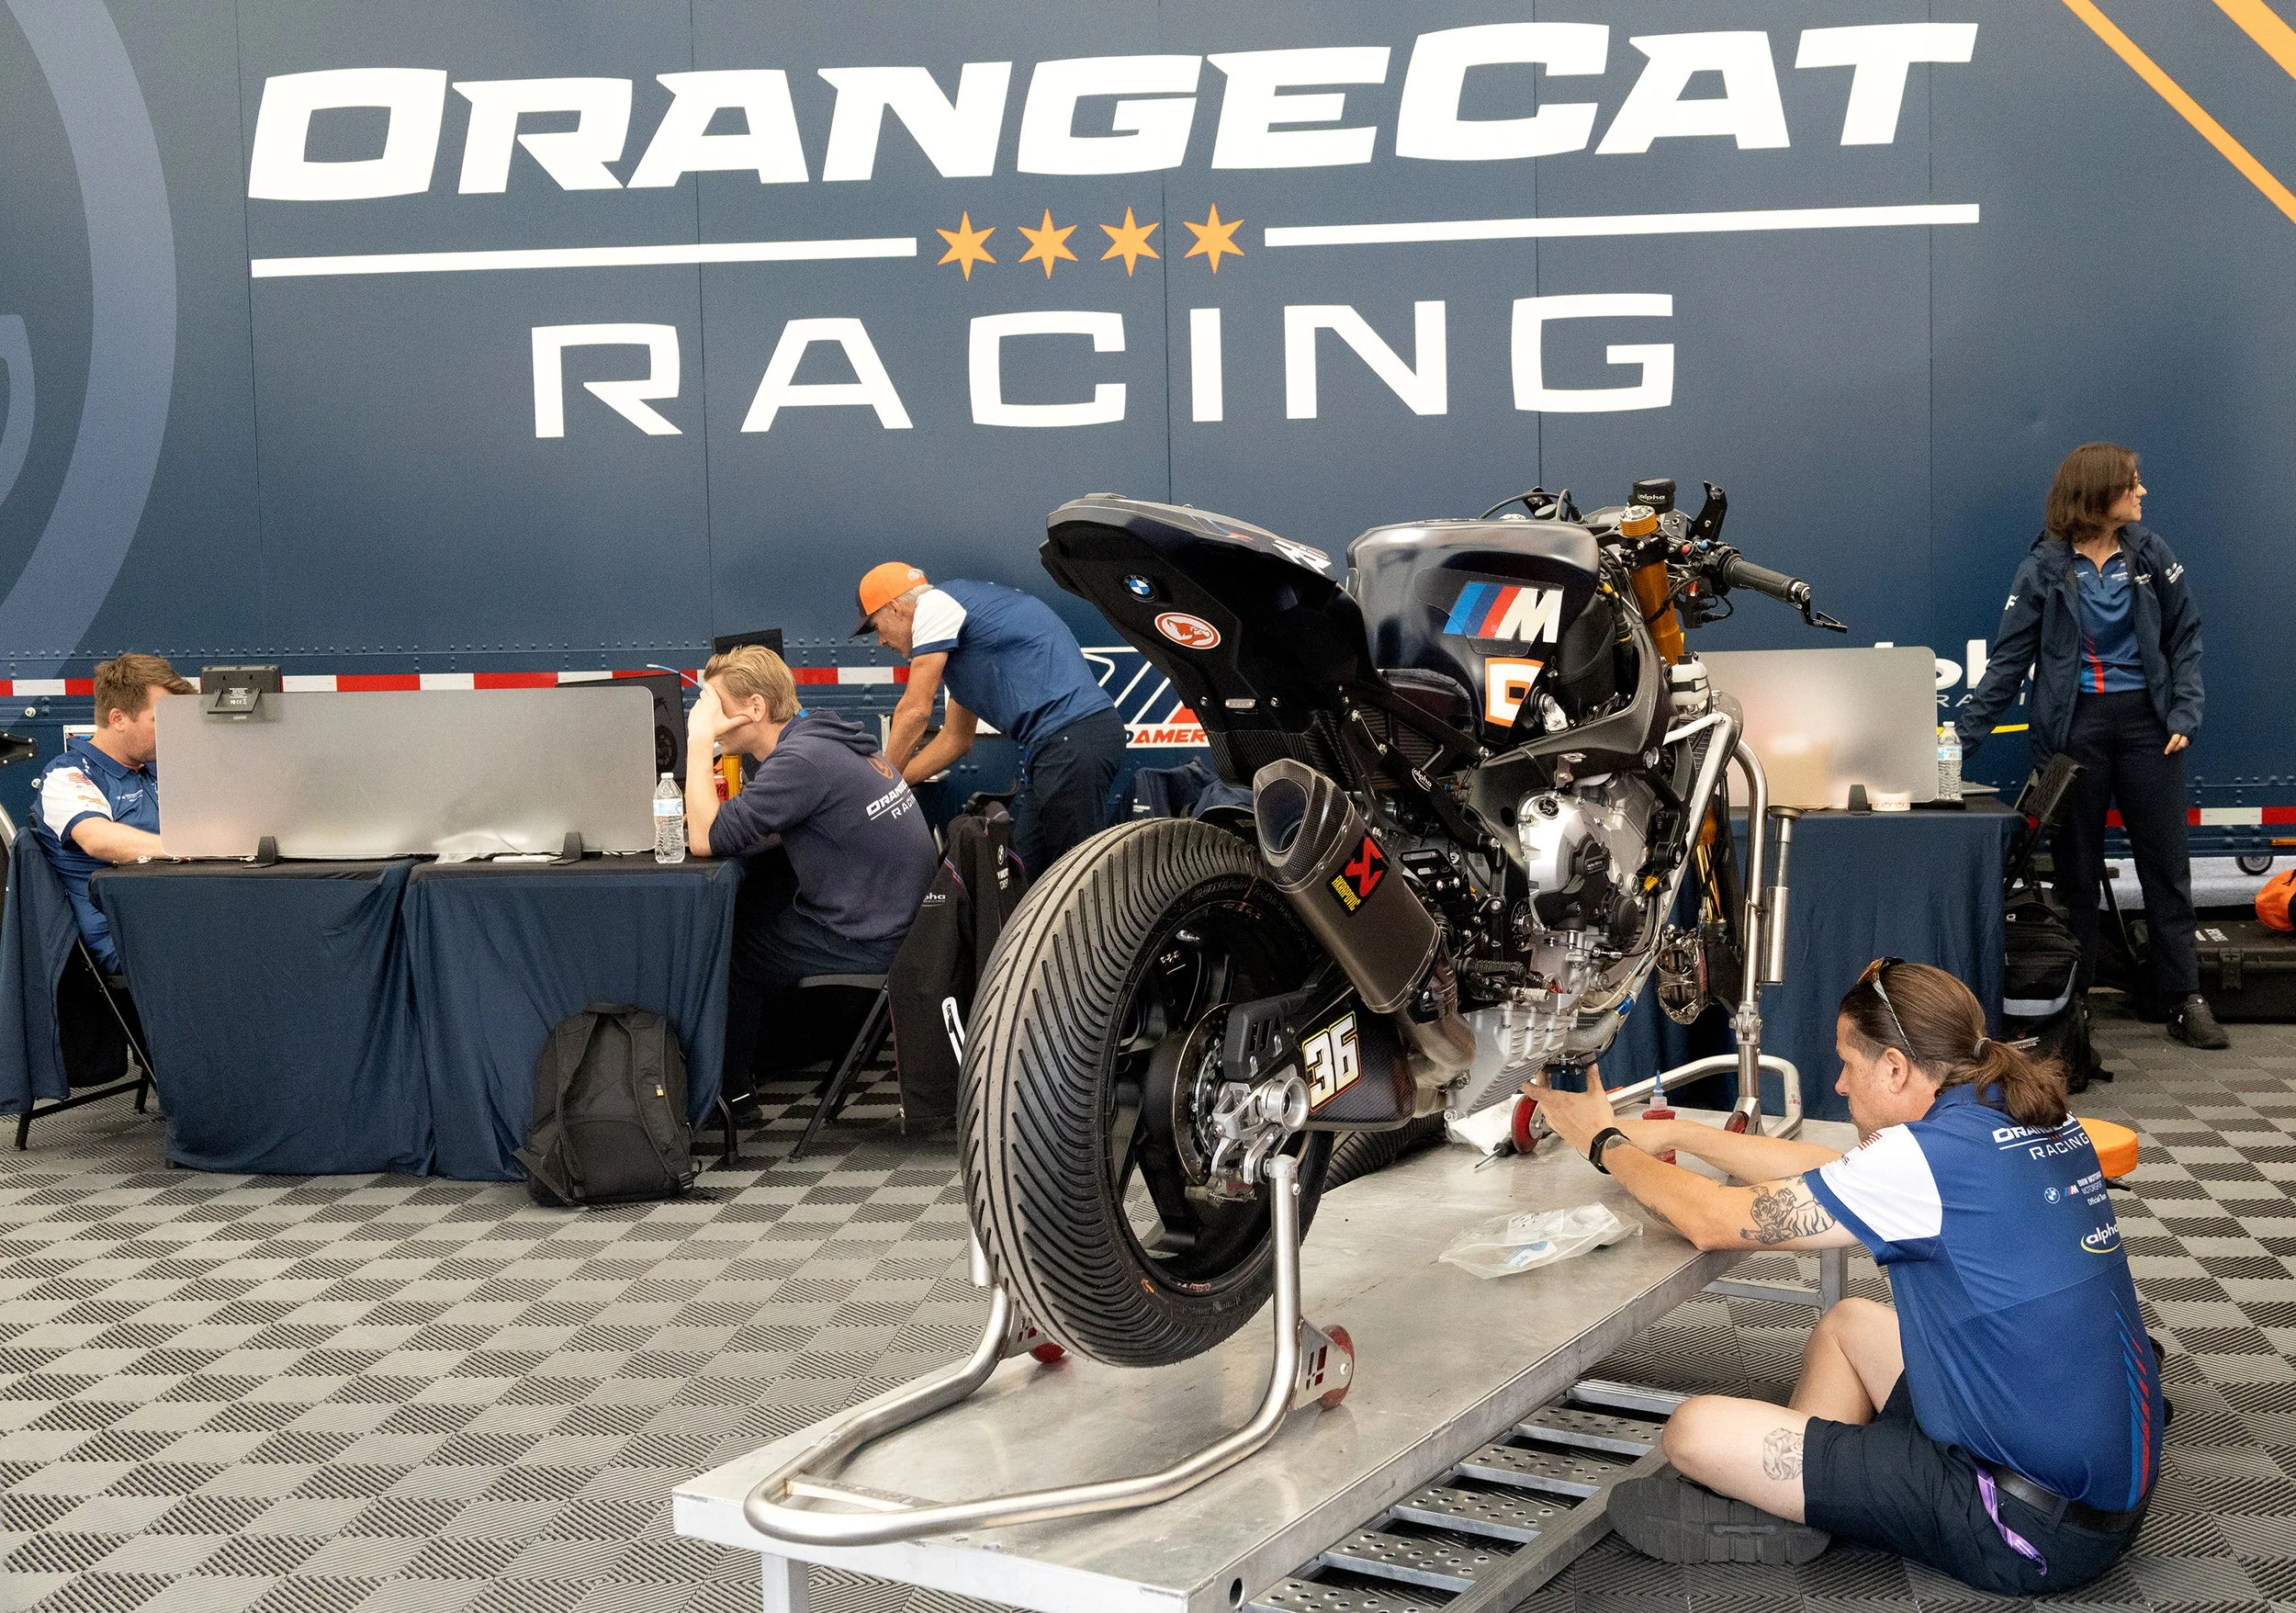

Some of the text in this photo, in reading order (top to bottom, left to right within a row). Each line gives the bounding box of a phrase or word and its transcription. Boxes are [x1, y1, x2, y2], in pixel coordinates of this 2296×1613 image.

[531, 293, 1674, 439] RACING
[1639, 493, 1666, 502] alpha
[1414, 770, 1433, 788] alpha
[1303, 1013, 1361, 1111] 36
[2029, 1133, 2090, 1160] RACING
